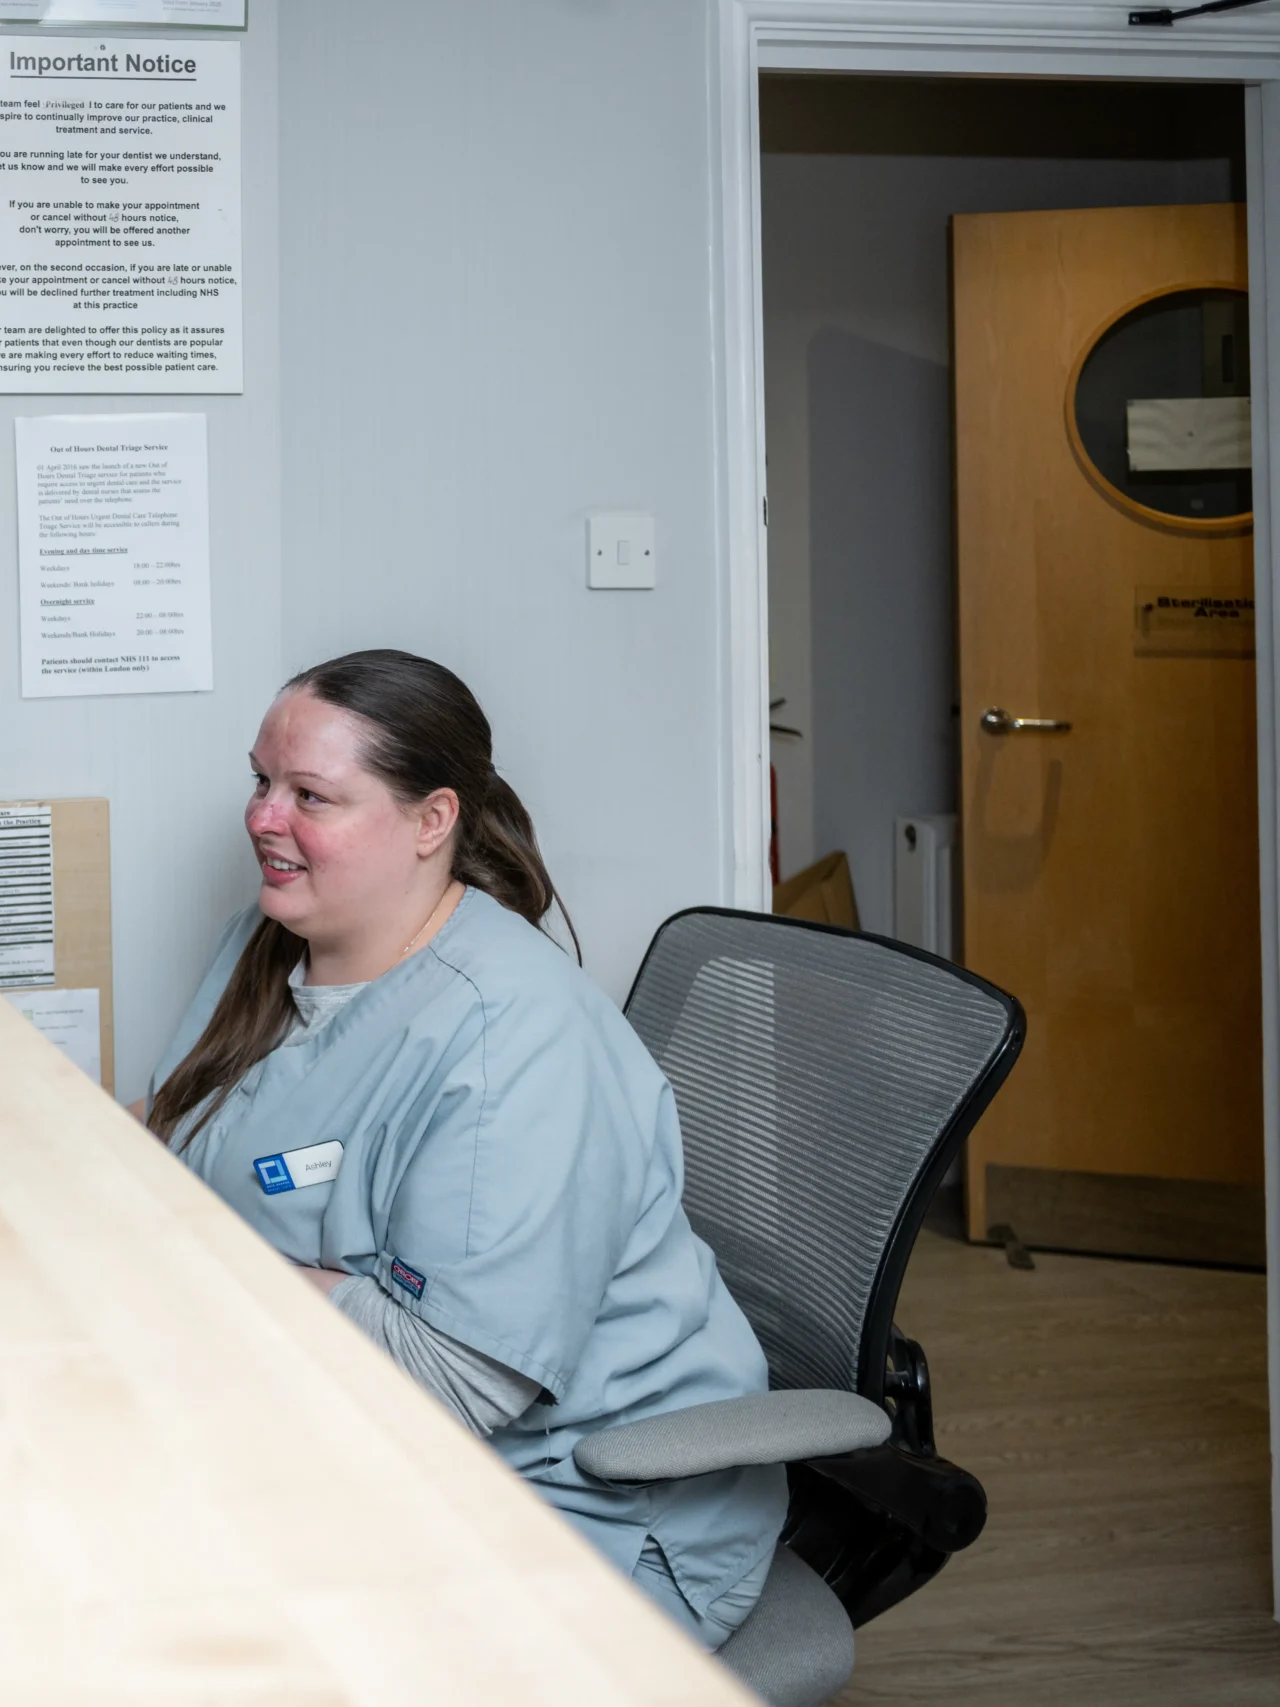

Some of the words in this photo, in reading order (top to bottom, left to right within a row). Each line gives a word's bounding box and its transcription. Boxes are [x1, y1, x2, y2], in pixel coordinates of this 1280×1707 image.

[10, 52, 118, 76] Important
[125, 54, 196, 73] Notice
[23, 99, 40, 107] feel
[45, 99, 85, 109] Privileged
[126, 101, 139, 109] for
[158, 102, 193, 110] patients
[35, 112, 84, 122] continually
[141, 114, 179, 123] practice,
[181, 114, 213, 122] clinical
[29, 151, 64, 160] running
[84, 150, 98, 158] for
[150, 164, 174, 172] effort
[176, 164, 213, 172] possible
[9, 199, 15, 207] If
[122, 202, 142, 210] your
[144, 202, 200, 210] appointment
[137, 265, 154, 273] you
[8, 277, 29, 285] your
[31, 276, 88, 284] appointment
[26, 288, 38, 296] be
[40, 288, 78, 296] declined
[80, 288, 110, 296] further
[156, 288, 197, 298] including
[44, 326, 86, 335] delighted
[99, 325, 120, 333] offer
[140, 326, 167, 335] policy
[24, 351, 58, 360] making
[86, 350, 110, 358] effort
[156, 350, 188, 360] waiting
[124, 363, 162, 371] possible
[1194, 607, 1240, 617] Area
[306, 1161, 332, 1171] Ashley
